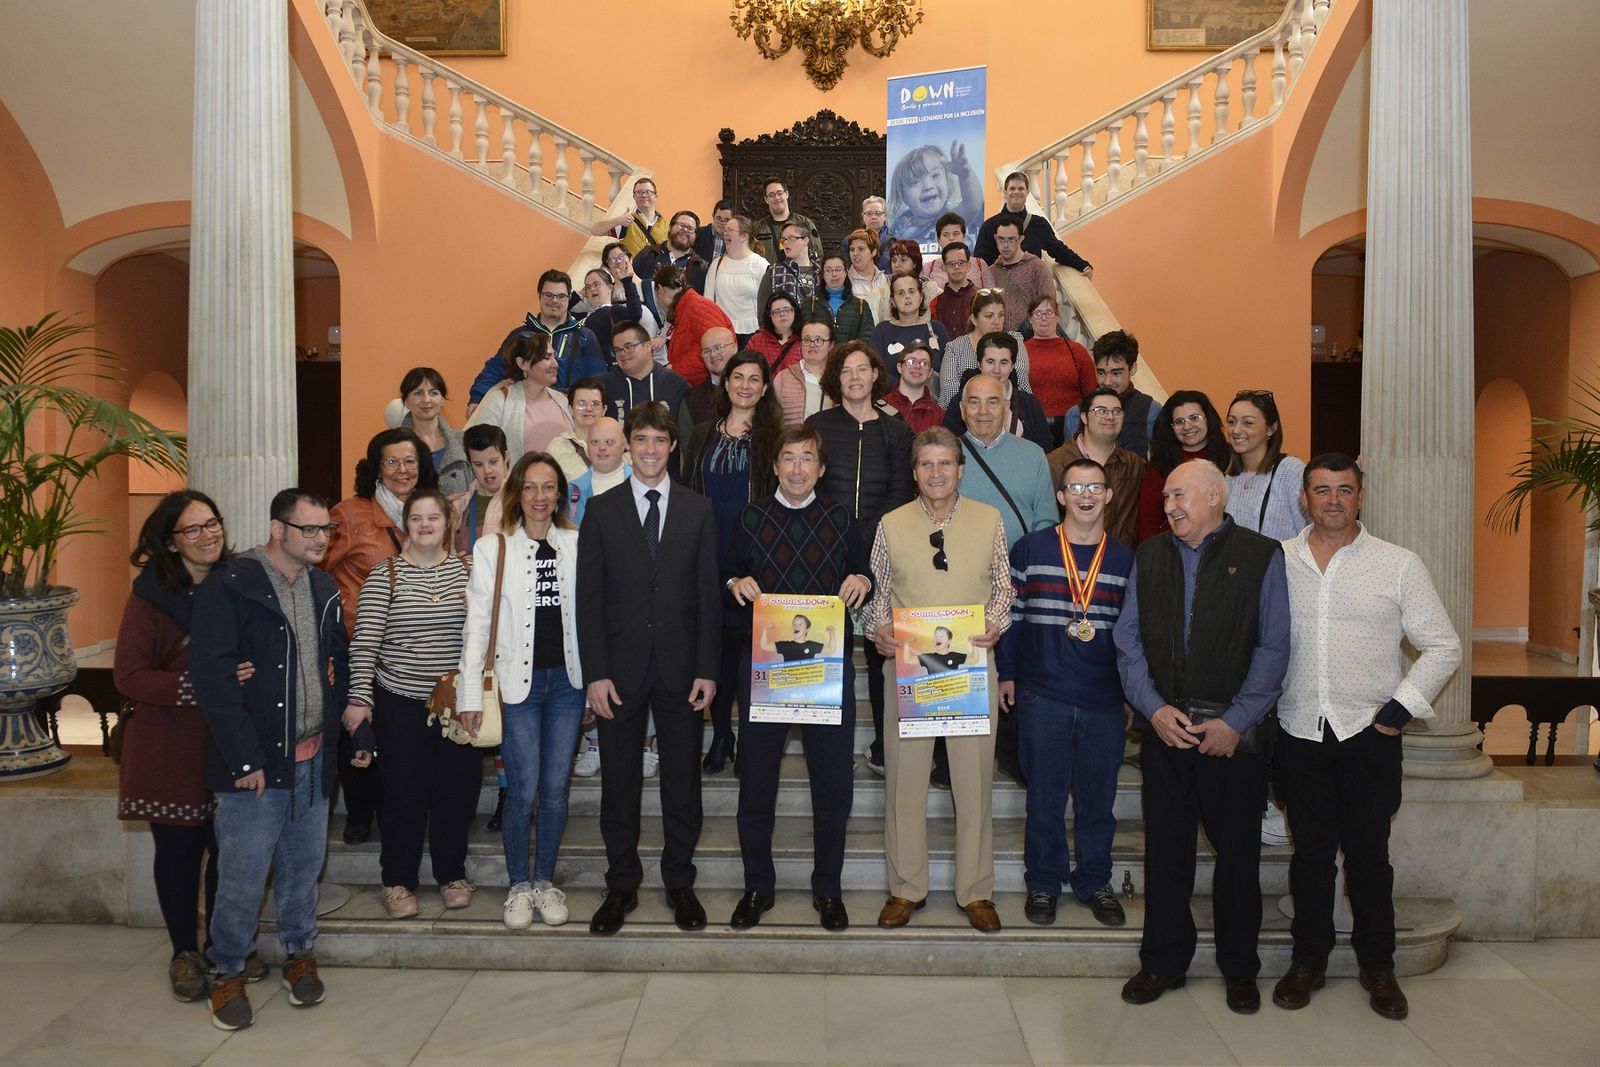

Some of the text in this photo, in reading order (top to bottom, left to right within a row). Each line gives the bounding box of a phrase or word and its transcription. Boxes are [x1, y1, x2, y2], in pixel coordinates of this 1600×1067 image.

[900, 81, 954, 104] DOWN
[918, 114, 943, 122] LUCHANDO
[960, 109, 985, 117] INCLUSIÓN
[753, 671, 767, 680] 31
[899, 685, 913, 695] 31
